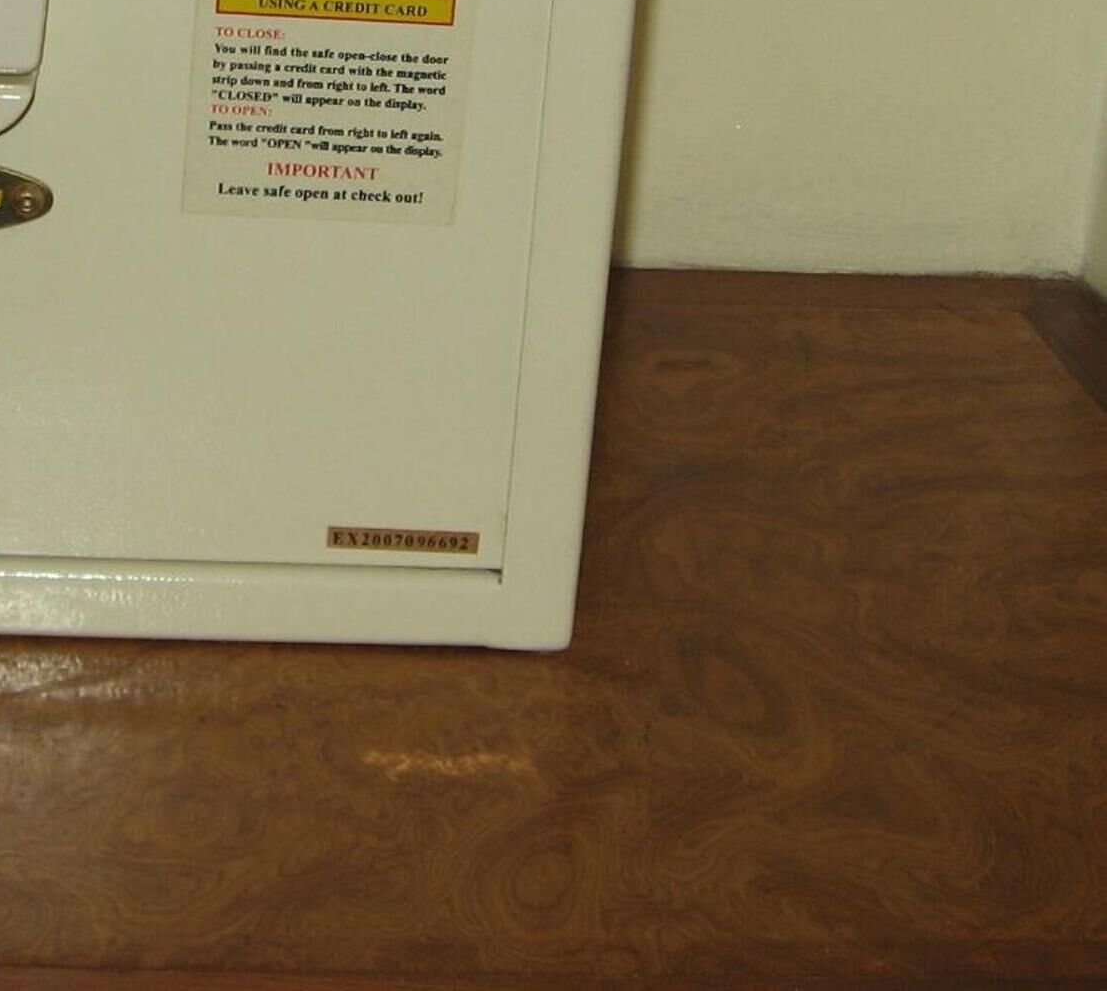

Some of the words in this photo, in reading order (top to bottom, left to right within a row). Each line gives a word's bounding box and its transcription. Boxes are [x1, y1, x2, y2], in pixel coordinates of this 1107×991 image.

[309, 0, 318, 11] A
[323, 0, 380, 14] CREDIT
[383, 3, 427, 17] CARD
[216, 26, 234, 36] TO
[214, 42, 236, 54] You
[239, 45, 261, 55] will
[264, 45, 287, 56] find
[290, 46, 308, 57] the
[311, 48, 334, 59] safe
[337, 50, 397, 62] open-close
[400, 52, 419, 63] the
[421, 53, 449, 64] door
[212, 58, 226, 71] by
[229, 60, 271, 73] passing
[274, 63, 280, 71] a
[283, 63, 316, 73] credit
[319, 64, 345, 74] card
[348, 65, 372, 76] with
[375, 66, 393, 77] the
[395, 69, 446, 81] magnetic
[211, 75, 237, 87] strip
[240, 75, 270, 86] down
[272, 77, 294, 88] and
[296, 78, 323, 89] from
[326, 79, 353, 92] right
[356, 82, 367, 91] to
[369, 81, 390, 92] left.
[393, 83, 414, 94] The
[417, 85, 446, 95] word
[211, 104, 228, 113] TO
[281, 93, 302, 104] will
[304, 96, 344, 107] appear
[347, 98, 361, 106] on
[363, 96, 382, 108] the
[383, 98, 426, 112] display.
[208, 120, 232, 130] Pass
[235, 121, 253, 132] the
[255, 123, 287, 133] credit
[289, 124, 315, 135] card
[317, 124, 344, 136] from
[347, 126, 374, 139] right
[376, 129, 387, 138] to
[390, 128, 408, 139] left
[410, 130, 443, 142] again.
[207, 135, 229, 146] The
[230, 137, 258, 148] word
[331, 143, 368, 154] appear
[369, 145, 383, 154] on
[385, 144, 402, 154] the
[403, 145, 443, 158] display.
[267, 161, 379, 180] IMPORTANT
[217, 182, 259, 196] Leave
[263, 184, 291, 197] safe
[294, 188, 328, 201] open
[332, 189, 347, 200] at
[350, 189, 391, 202] check
[394, 191, 423, 204] out!
